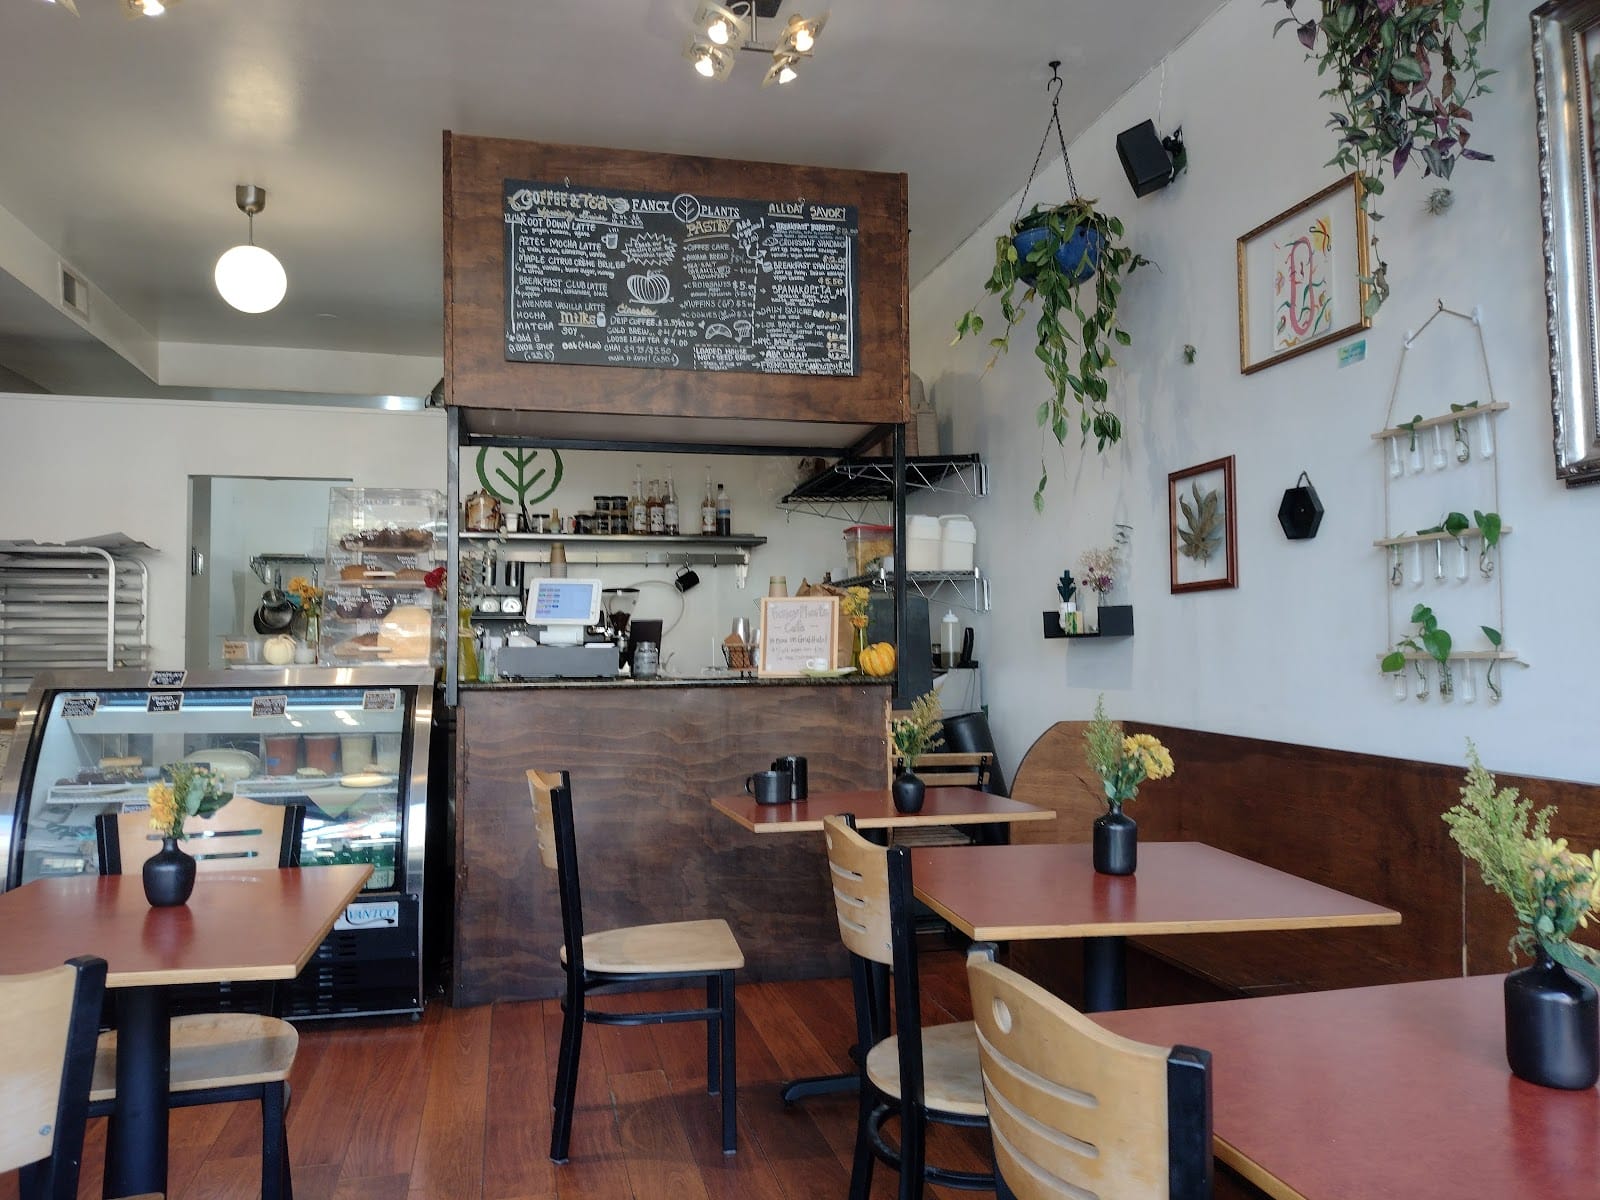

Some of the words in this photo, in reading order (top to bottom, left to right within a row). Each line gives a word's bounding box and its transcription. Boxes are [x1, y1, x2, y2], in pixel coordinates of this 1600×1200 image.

[570, 193, 581, 208] &
[632, 199, 669, 212] FANCY
[701, 205, 740, 218] PLANTS
[810, 206, 846, 220] SAVORY
[520, 216, 543, 227] ROOT
[546, 220, 570, 230] DOWN
[572, 222, 596, 232] LATTE
[686, 219, 734, 237] PASTRY
[519, 236, 545, 246] AZTEC
[550, 238, 577, 249] MOCHA
[579, 242, 602, 251] LATTE
[519, 253, 545, 264] MAPLE
[548, 256, 573, 266] CITRUS
[773, 261, 811, 269] BREAKFAST
[519, 276, 562, 288] BREAKFAST
[566, 280, 585, 289] CLUB
[587, 282, 608, 291] LATTE
[772, 284, 832, 294] SPANAKOPITA
[517, 300, 553, 309] LAVENDER
[555, 301, 582, 311] VANILLA
[585, 303, 606, 312] LATTE
[517, 311, 546, 320] MOCHA
[610, 315, 627, 325] DRIP
[516, 322, 554, 331] MATCHA
[562, 327, 578, 336] SOY
[606, 326, 625, 335] COLD
[606, 335, 628, 344] LOOSE
[630, 335, 646, 343] LEAF
[647, 337, 660, 345] TEA
[603, 344, 620, 353] CHAI
